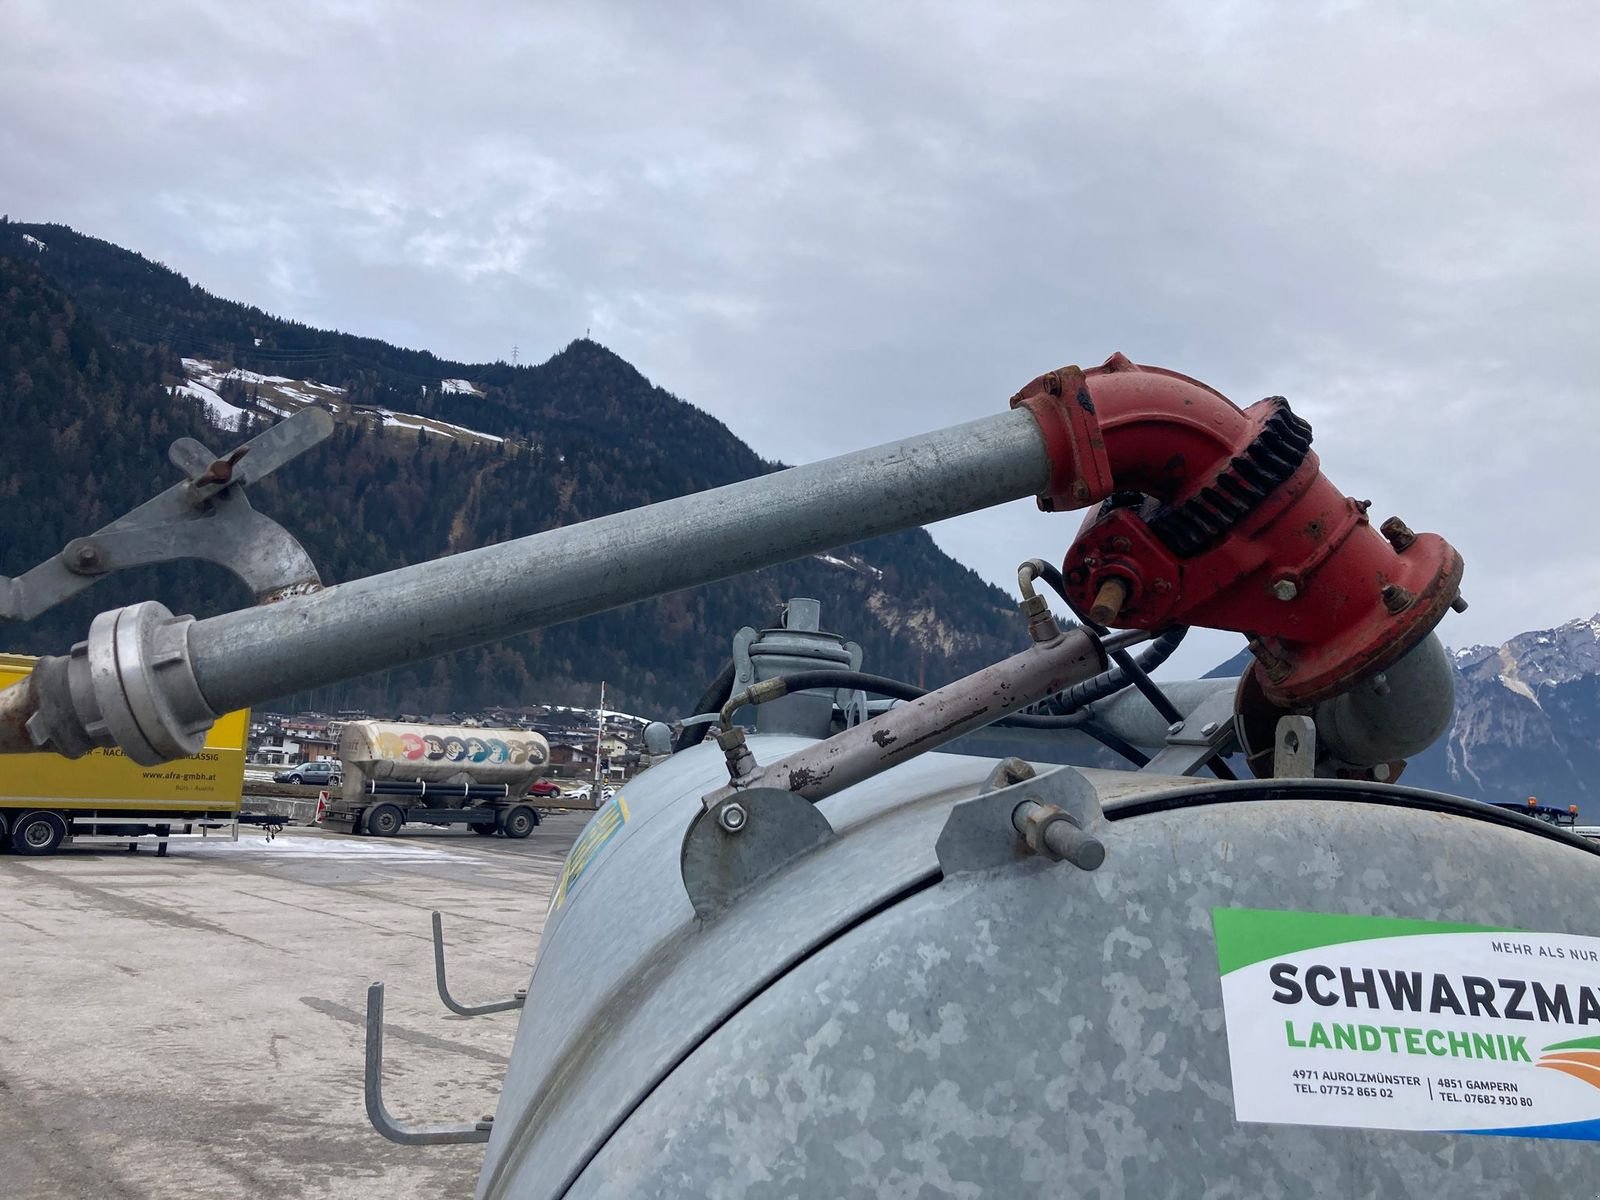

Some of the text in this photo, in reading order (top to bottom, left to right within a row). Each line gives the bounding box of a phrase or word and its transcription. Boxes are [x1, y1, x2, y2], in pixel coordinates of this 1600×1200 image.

[142, 770, 217, 782] www.afra-gmbh.at
[1491, 941, 1599, 962] MEHR ALS NUR
[1269, 962, 1600, 1025] SCHWARZMA
[1285, 1020, 1533, 1062] LANDTECHNIK
[1292, 1069, 1422, 1086] 4971 AUROLZMÜNSTER
[1437, 1078, 1518, 1092] 4851 GAMPERN
[1293, 1083, 1394, 1098] TEL. 07752 865 02
[1439, 1091, 1533, 1107] TEL. 07682 930 80
